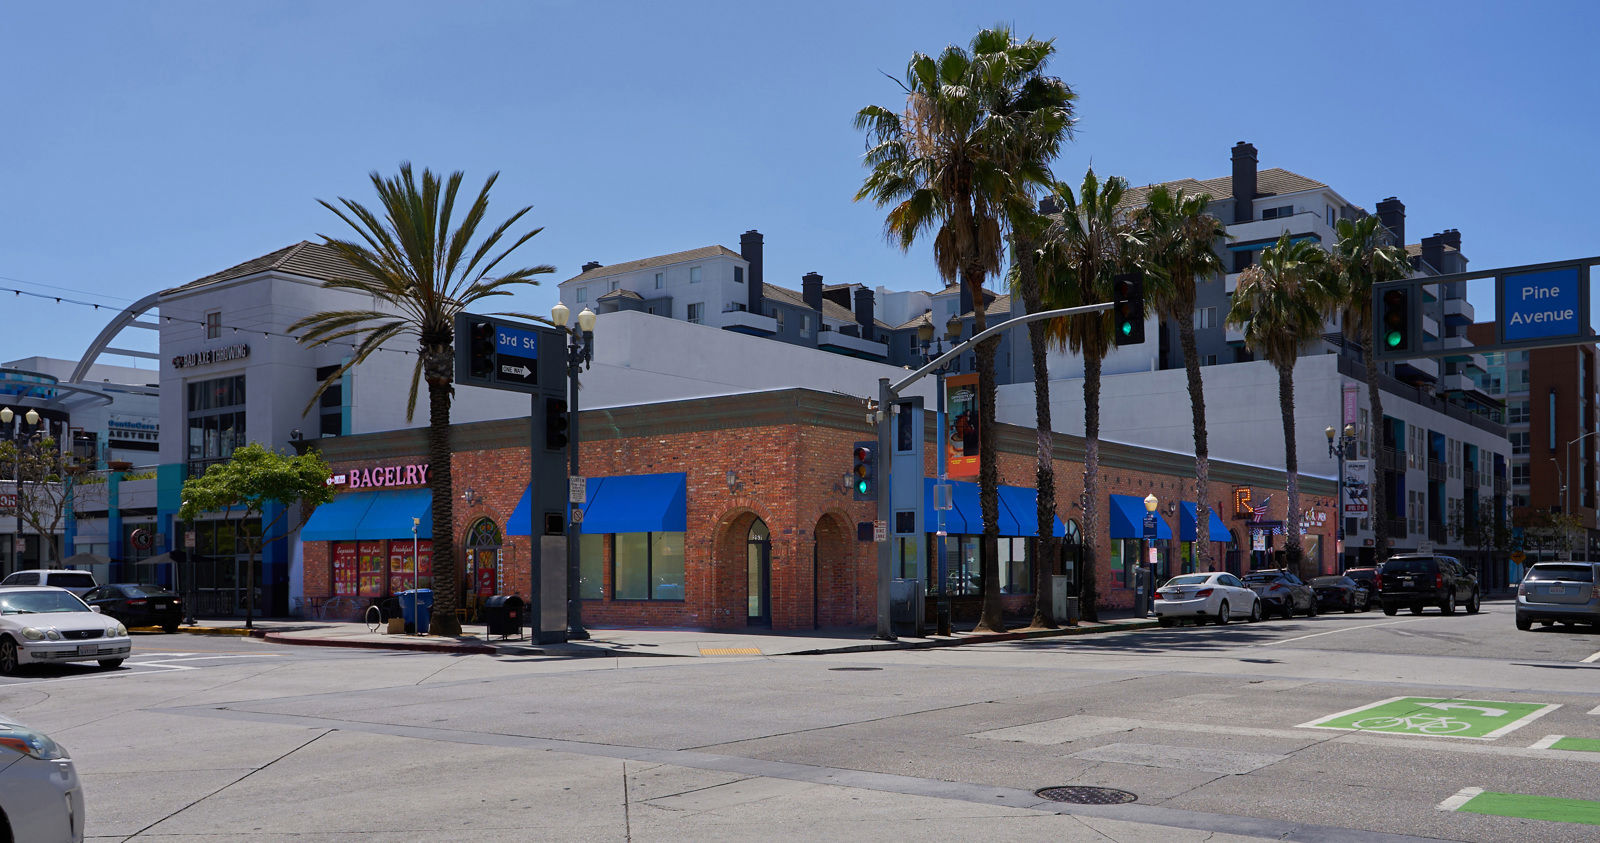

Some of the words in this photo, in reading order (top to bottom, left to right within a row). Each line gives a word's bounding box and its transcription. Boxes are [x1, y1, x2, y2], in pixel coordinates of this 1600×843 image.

[1522, 286, 1560, 300] Pine
[1510, 309, 1574, 325] Avenue
[499, 333, 517, 346] 3rd
[523, 337, 535, 349] St
[183, 354, 197, 367] BAD
[198, 351, 211, 365] AXE
[212, 344, 247, 361] THROWING
[350, 464, 429, 488] BAGELRY
[1236, 488, 1254, 513] R
